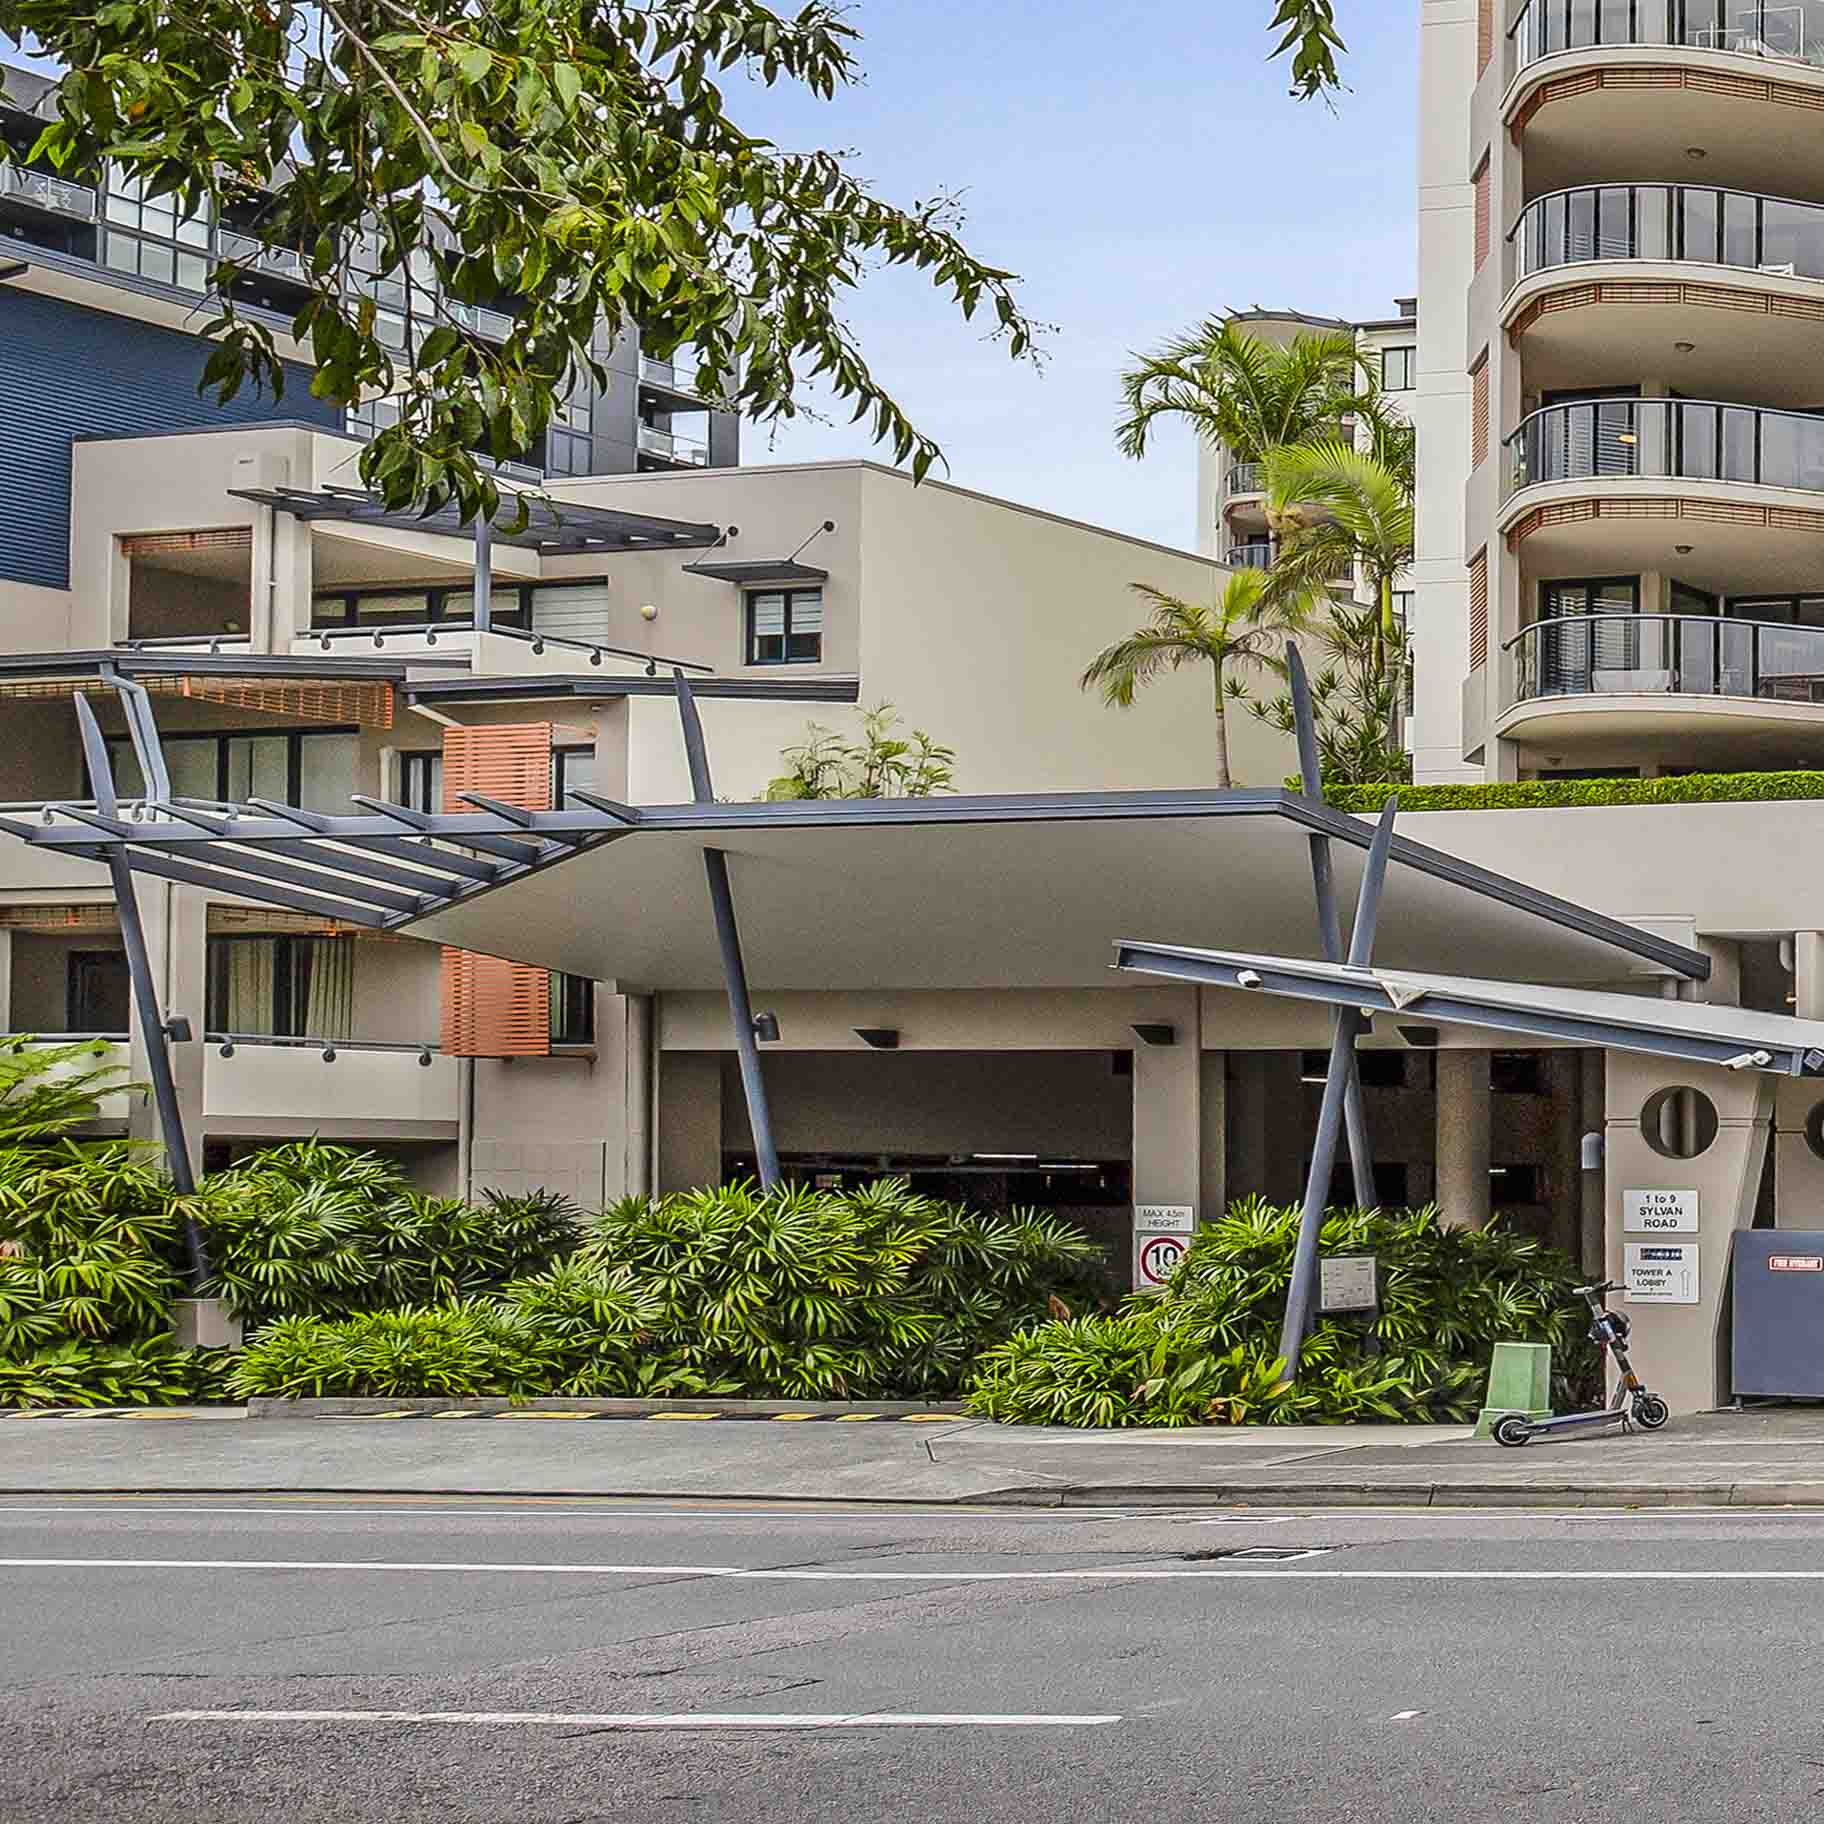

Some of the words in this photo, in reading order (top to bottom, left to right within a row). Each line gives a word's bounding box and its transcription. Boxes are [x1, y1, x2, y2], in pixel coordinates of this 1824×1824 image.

[1645, 1195, 1650, 1203] 1
[1655, 1195, 1666, 1204] to
[1670, 1195, 1676, 1204] 9
[1639, 1207, 1683, 1216] SYLVAN
[1643, 1219, 1678, 1228] ROAD
[1151, 1246, 1178, 1267] 10
[1631, 1269, 1664, 1277] TOWER
[1665, 1269, 1673, 1277] A
[1636, 1279, 1667, 1287] LOBBY
